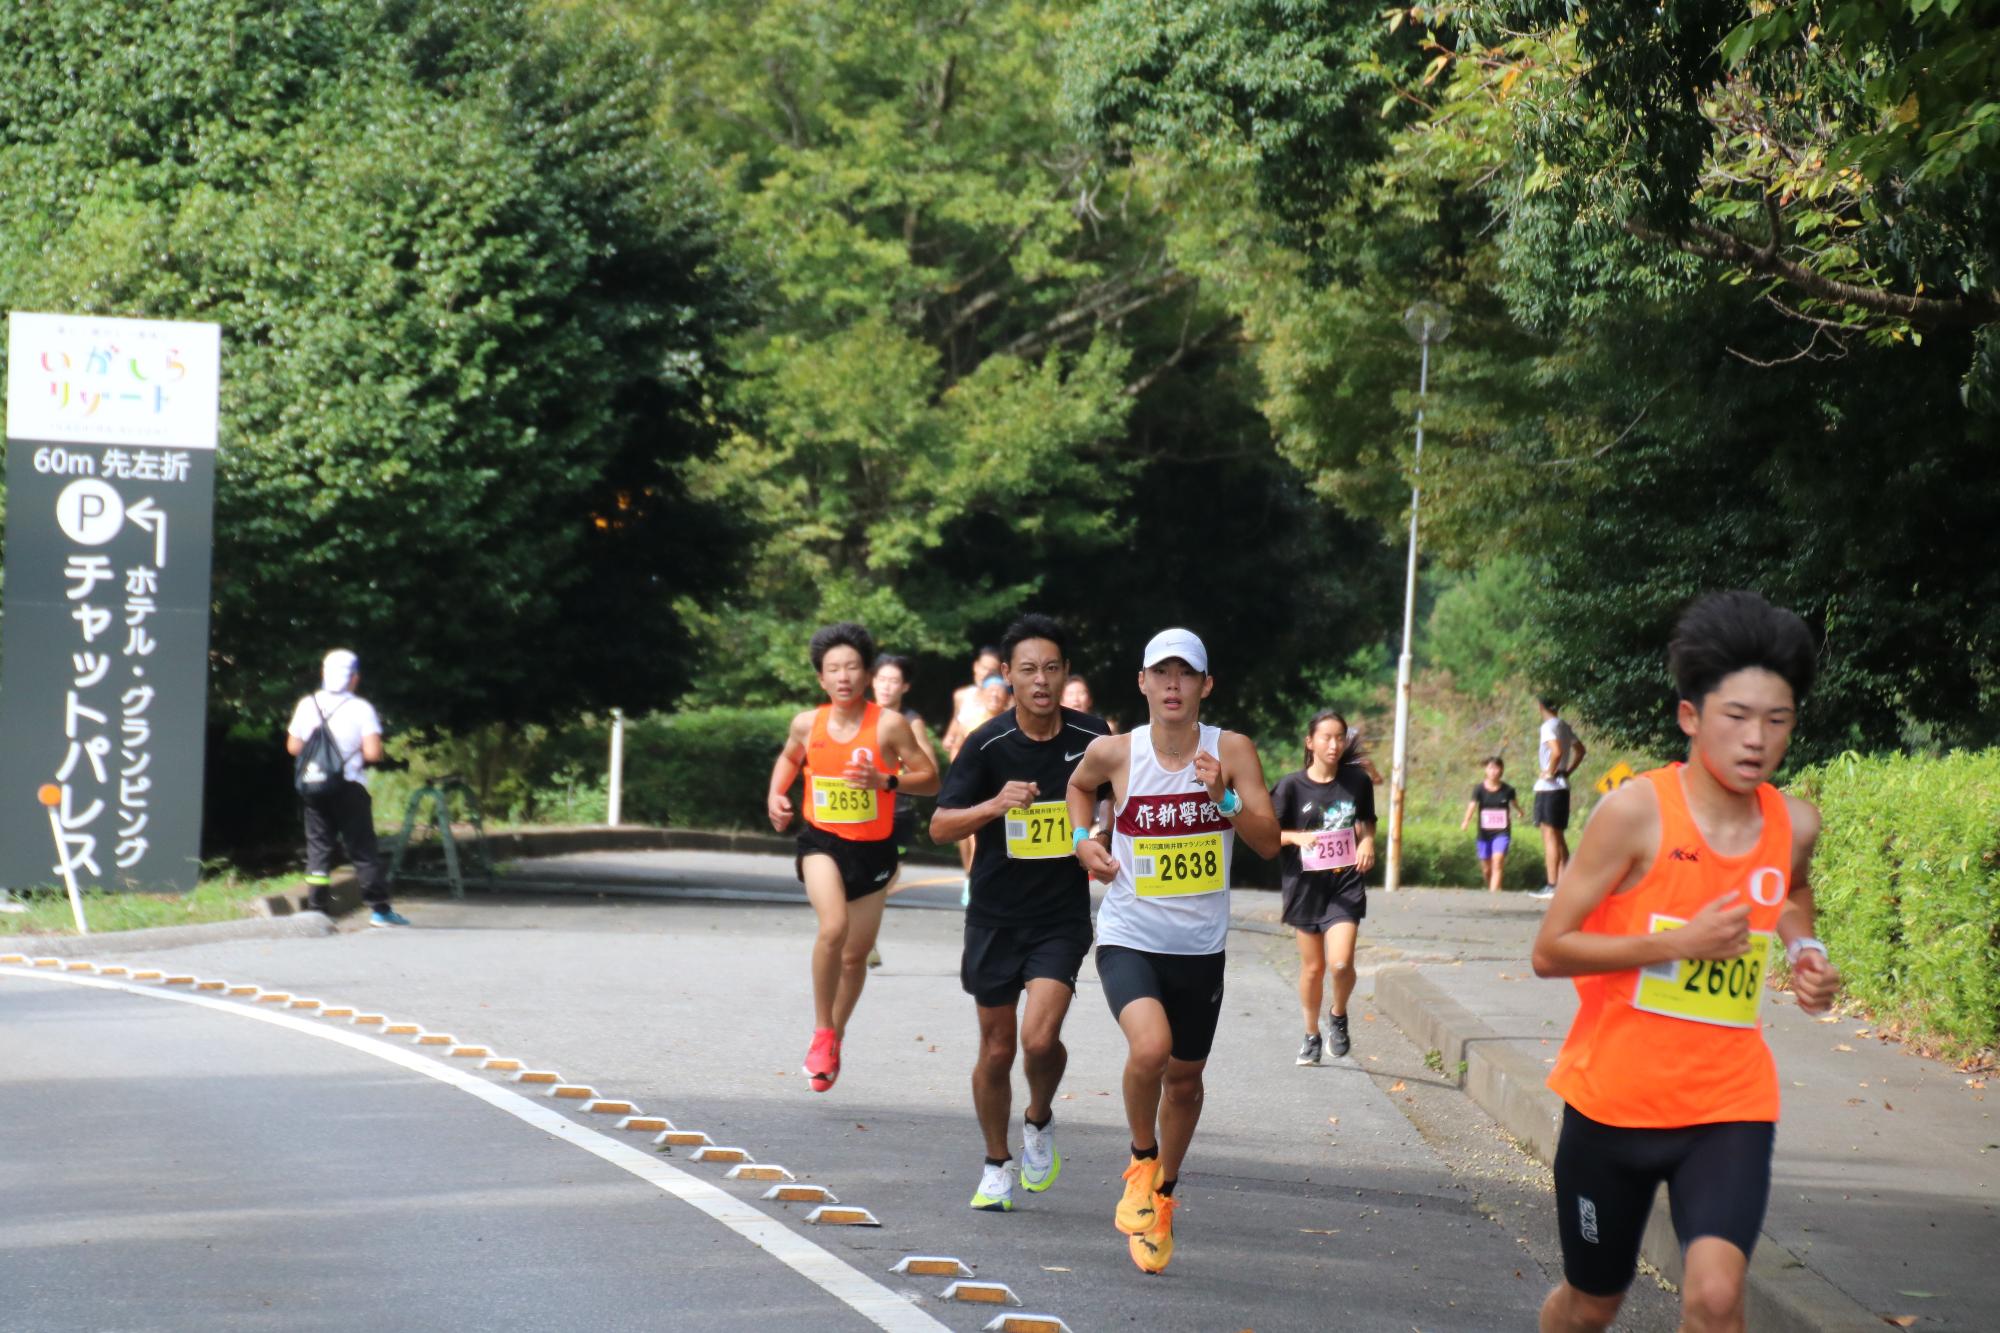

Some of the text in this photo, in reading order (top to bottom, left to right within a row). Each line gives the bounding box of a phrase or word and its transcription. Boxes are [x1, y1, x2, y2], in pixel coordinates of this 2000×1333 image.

[41, 345, 187, 381] いがしら
[34, 447, 191, 482] 60m 先左折
[78, 495, 106, 532] P
[53, 555, 115, 877] チャットパレス
[114, 565, 158, 869] ホテル・グランピング
[829, 790, 871, 811] 2653
[1134, 800, 1221, 829] 作新學院
[1030, 817, 1074, 844] 271
[1159, 850, 1217, 881] 2638
[1318, 840, 1350, 860] 2531
[1684, 958, 1760, 1001] 2608
